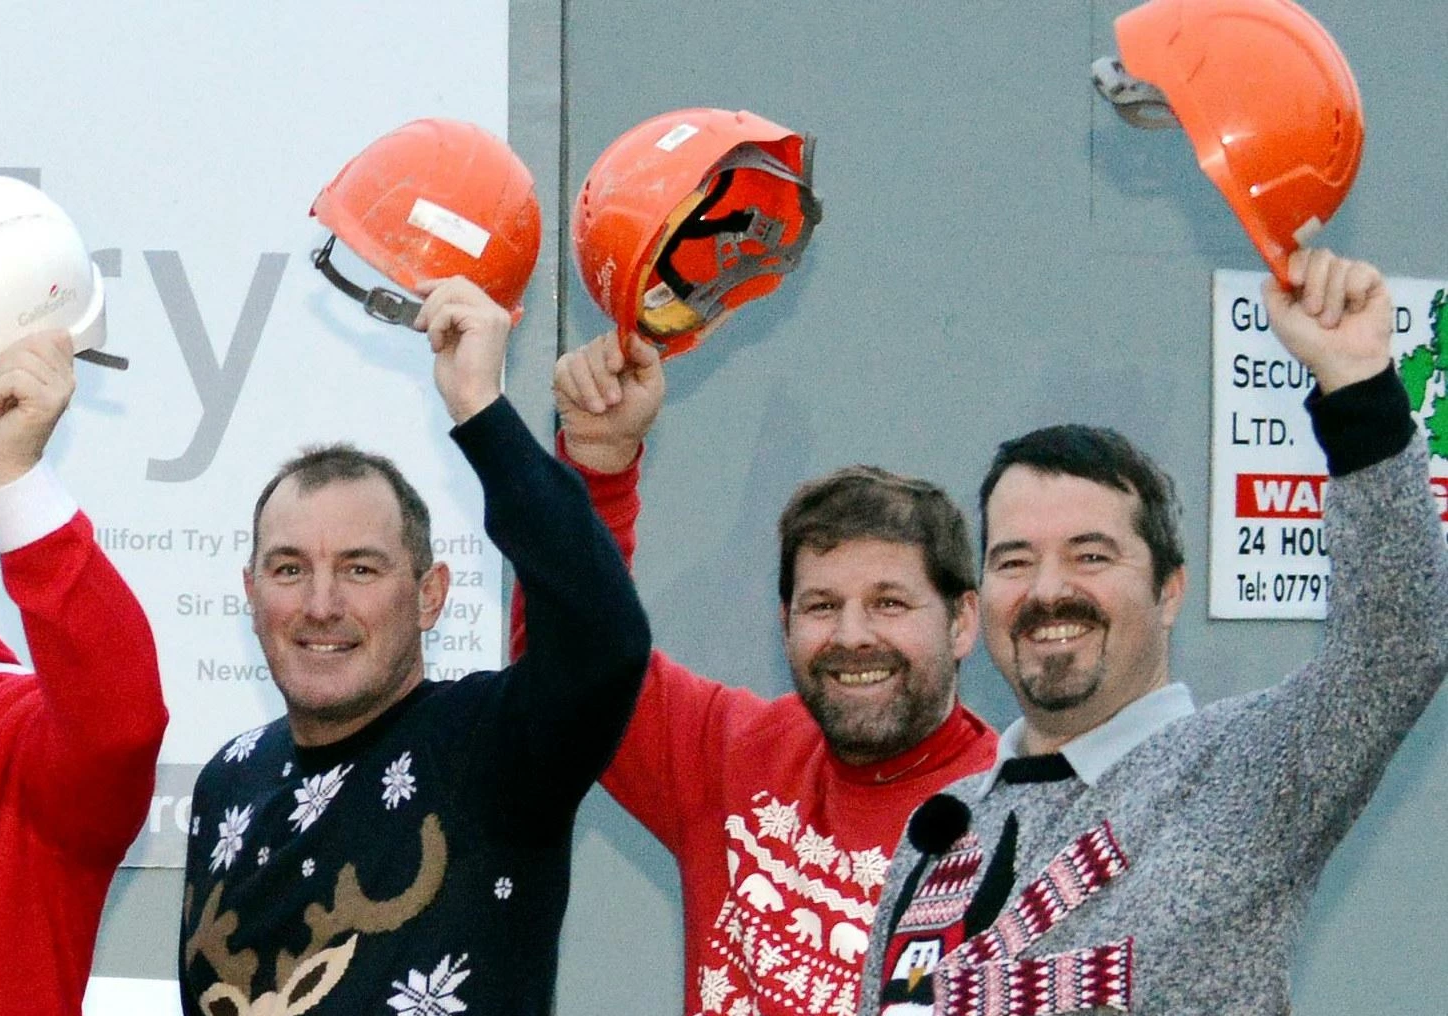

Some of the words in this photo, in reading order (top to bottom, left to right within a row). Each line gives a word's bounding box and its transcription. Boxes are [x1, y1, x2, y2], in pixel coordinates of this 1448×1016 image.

[181, 529, 224, 557] Try
[432, 534, 483, 554] orth
[1238, 526, 1265, 555] 24
[1237, 571, 1267, 602] Tel:
[176, 594, 214, 616] Sir
[425, 630, 483, 651] Park
